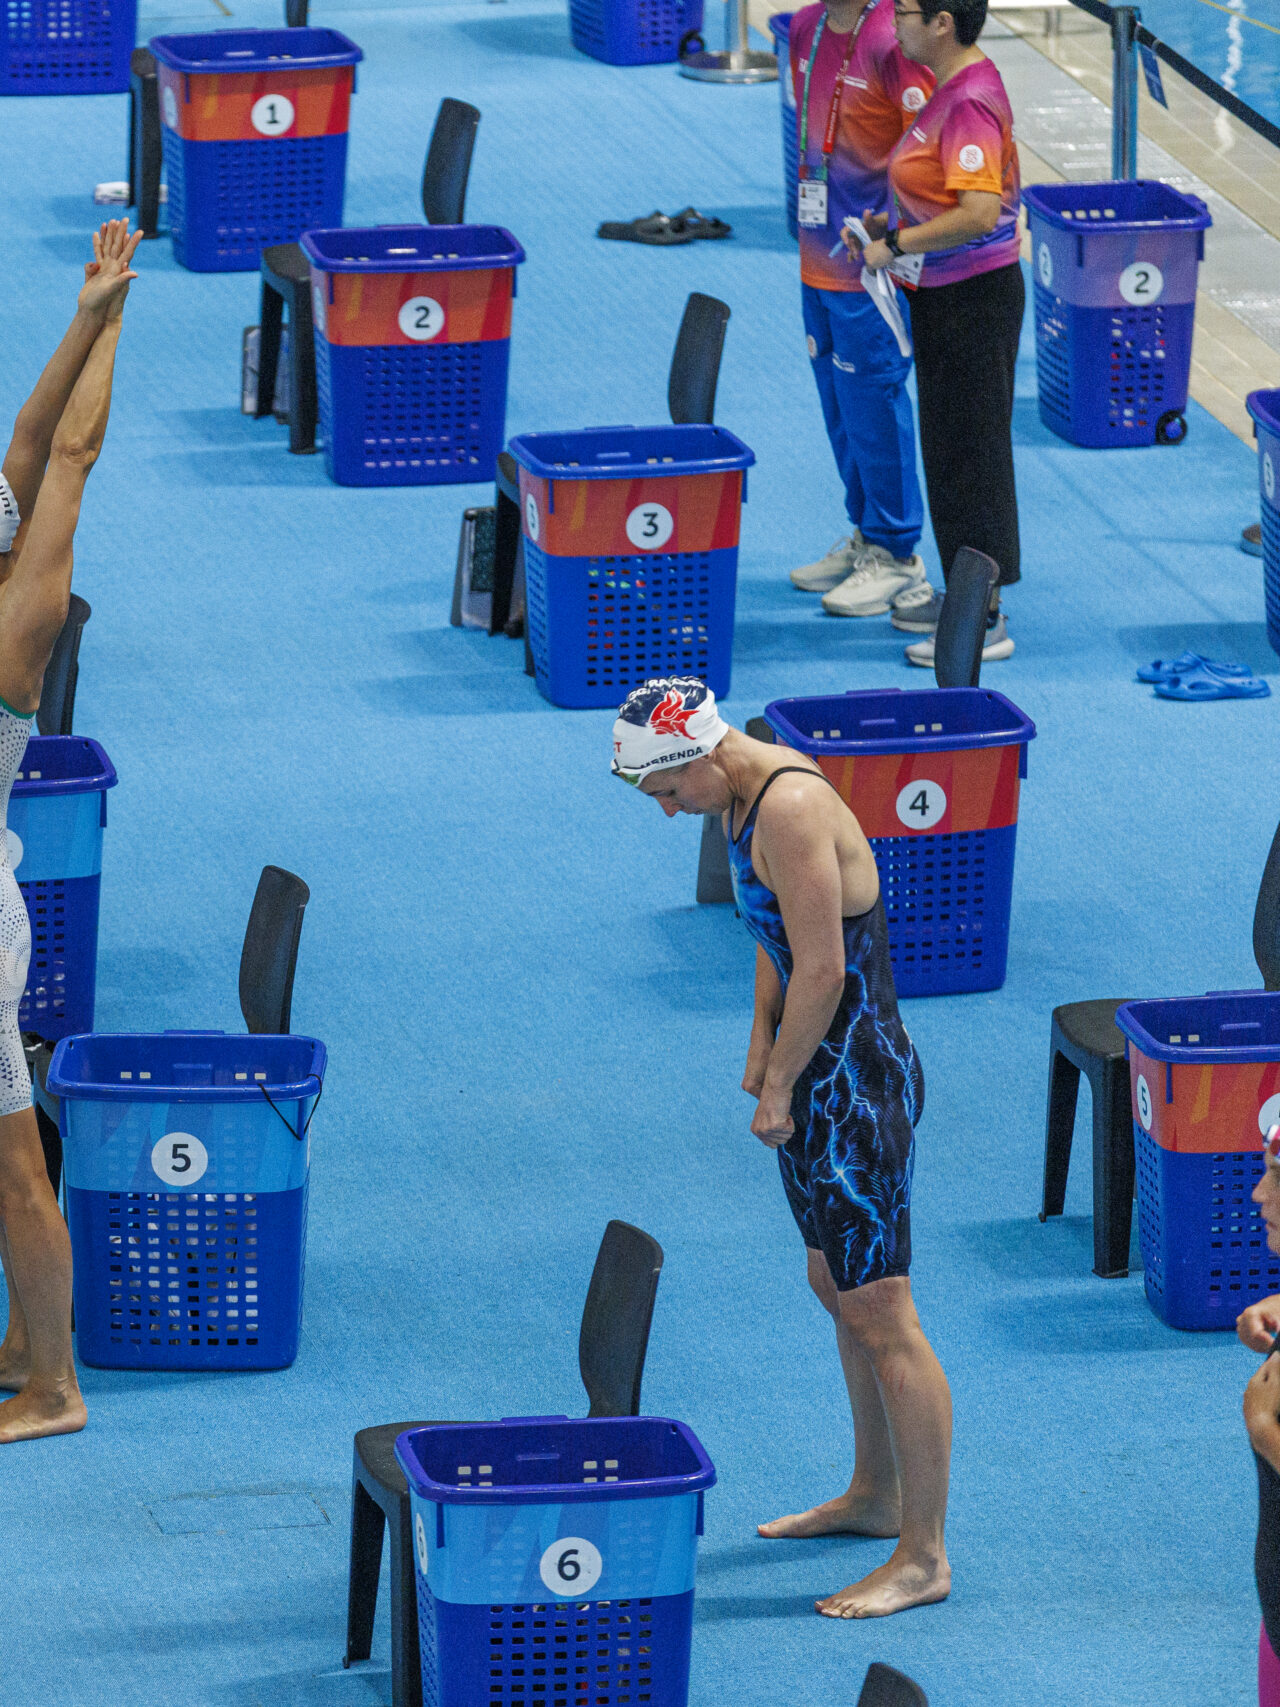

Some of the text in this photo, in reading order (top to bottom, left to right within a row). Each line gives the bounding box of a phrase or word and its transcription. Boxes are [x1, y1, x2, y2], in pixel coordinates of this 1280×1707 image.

[266, 103, 280, 124] 1
[1134, 270, 1150, 294] 2
[414, 304, 430, 329] 2
[642, 511, 659, 538] 3
[909, 790, 930, 816] 4
[1141, 1085, 1148, 1117] 5
[171, 1143, 192, 1173] 5
[557, 1548, 581, 1582] 6
